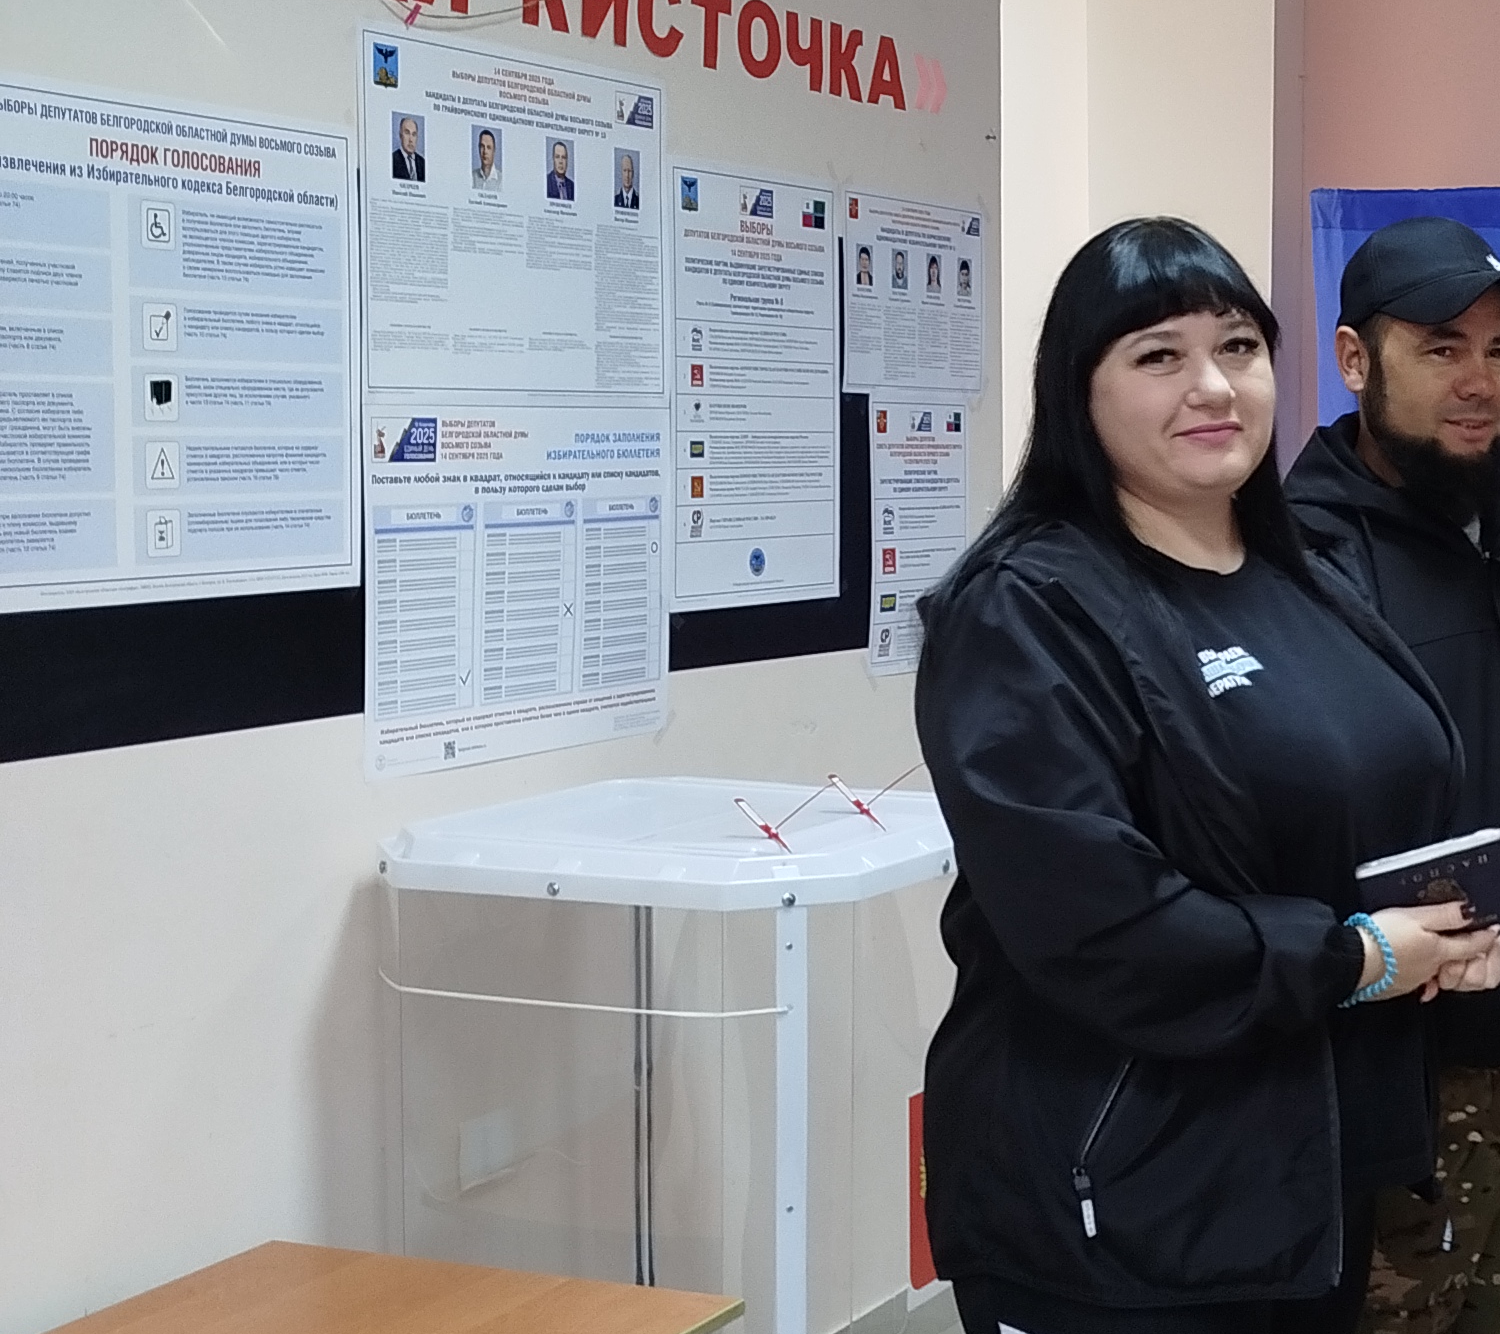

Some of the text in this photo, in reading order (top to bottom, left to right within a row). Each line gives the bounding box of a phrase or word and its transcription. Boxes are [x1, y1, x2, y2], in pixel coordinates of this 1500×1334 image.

[40, 104, 97, 125] ДЕПУТАТОВ
[100, 112, 173, 136] БЕЛГОРОДСКОЙ
[176, 123, 228, 144] ОБЛАСТНОЙ
[230, 131, 256, 148] ДУМЫ
[259, 135, 302, 154] ВОСЬМОГО
[304, 142, 336, 159] СОЗЫВА
[89, 137, 261, 178] ПОРЯДОК ГОЛОСОВАНИЯ
[69, 164, 84, 180] из
[87, 166, 178, 191] Избирательного
[181, 177, 222, 197] кодекса
[226, 182, 294, 205] Белгородской
[297, 190, 338, 210] области)
[740, 220, 773, 236] ВЫБОРЫ
[441, 420, 496, 428] ВЫБОРЫ ДЕПУТАТОВ
[410, 428, 435, 444] 2025
[441, 429, 529, 439] БЕЛГОРОДСКОЙ ОБЛАСТНОЙ ДУМЫ
[575, 432, 660, 444] ПОРЯДОК ЗАПОЛНЕНИЯ
[441, 441, 492, 449] ВОСЬМОГО СОЗЫВА
[546, 448, 660, 461] ИЗБИРАТЕЛЬНОГО БЮЛЛЕТЕНЯ
[372, 474, 411, 485] Поставьте
[413, 473, 440, 484] любой
[442, 475, 461, 483] знак
[463, 475, 467, 483] в
[470, 474, 502, 485] квадрат,
[505, 471, 551, 482] относящийся
[558, 471, 590, 480] кандидату
[603, 470, 624, 479] списку
[625, 469, 660, 478] кандидатов,
[475, 482, 586, 495] в пользу которого сделан выбор
[406, 511, 441, 520] БЮЛЛЕТЕНЬ
[516, 507, 548, 516] БЮЛЛЕТЕНЬ
